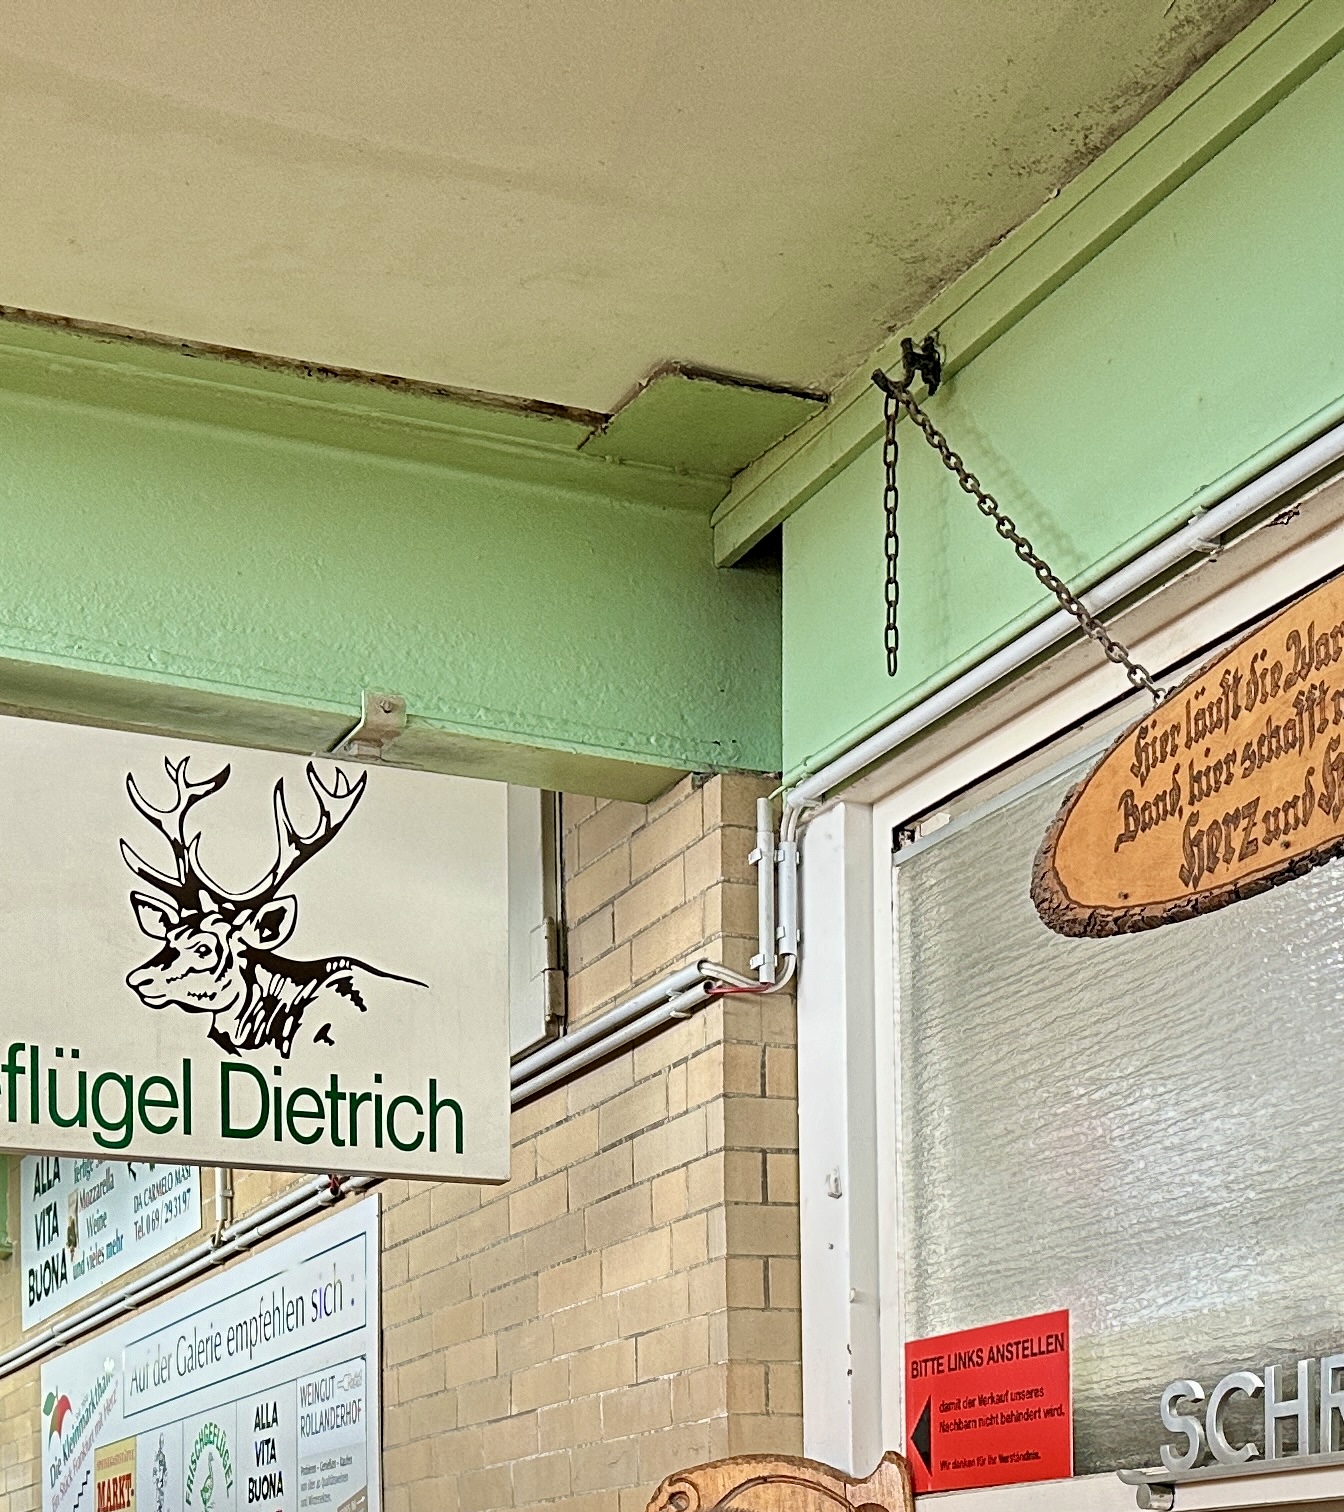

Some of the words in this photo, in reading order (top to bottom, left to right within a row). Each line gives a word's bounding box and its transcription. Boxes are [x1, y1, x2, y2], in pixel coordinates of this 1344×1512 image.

[1130, 718, 1183, 786] Hier
[1243, 648, 1281, 710] die
[1186, 750, 1238, 807] hier
[1237, 681, 1331, 780] schafft
[1178, 797, 1261, 889] Herz
[1261, 768, 1317, 846] und
[219, 1060, 465, 1154] Dietrich
[33, 1156, 61, 1202] ALLA
[79, 1167, 114, 1212] Mozzarella
[144, 1172, 173, 1207] CARMELO
[34, 1201, 59, 1251] VITA
[86, 1209, 107, 1238] Weine
[29, 1247, 68, 1307] BUONA
[73, 1250, 85, 1280] und
[86, 1242, 105, 1271] vieles
[106, 1228, 124, 1260] mehr
[130, 1350, 150, 1397] Auf
[153, 1344, 172, 1387] der
[176, 1322, 222, 1376] Galerie
[227, 1286, 305, 1360] empfehlen
[311, 1262, 343, 1322] sich
[911, 1356, 944, 1379] BITTE
[947, 1348, 984, 1372] LINKS
[986, 1332, 1065, 1365] ANSTELLEN
[300, 1375, 335, 1408] WEINGUT
[254, 1401, 279, 1432] ALLA
[300, 1398, 362, 1438] ROLLANDERHOF
[185, 1422, 234, 1506] FRISCHGEFLÜGEL
[254, 1438, 277, 1468] VITA
[248, 1471, 284, 1504] BUONA
